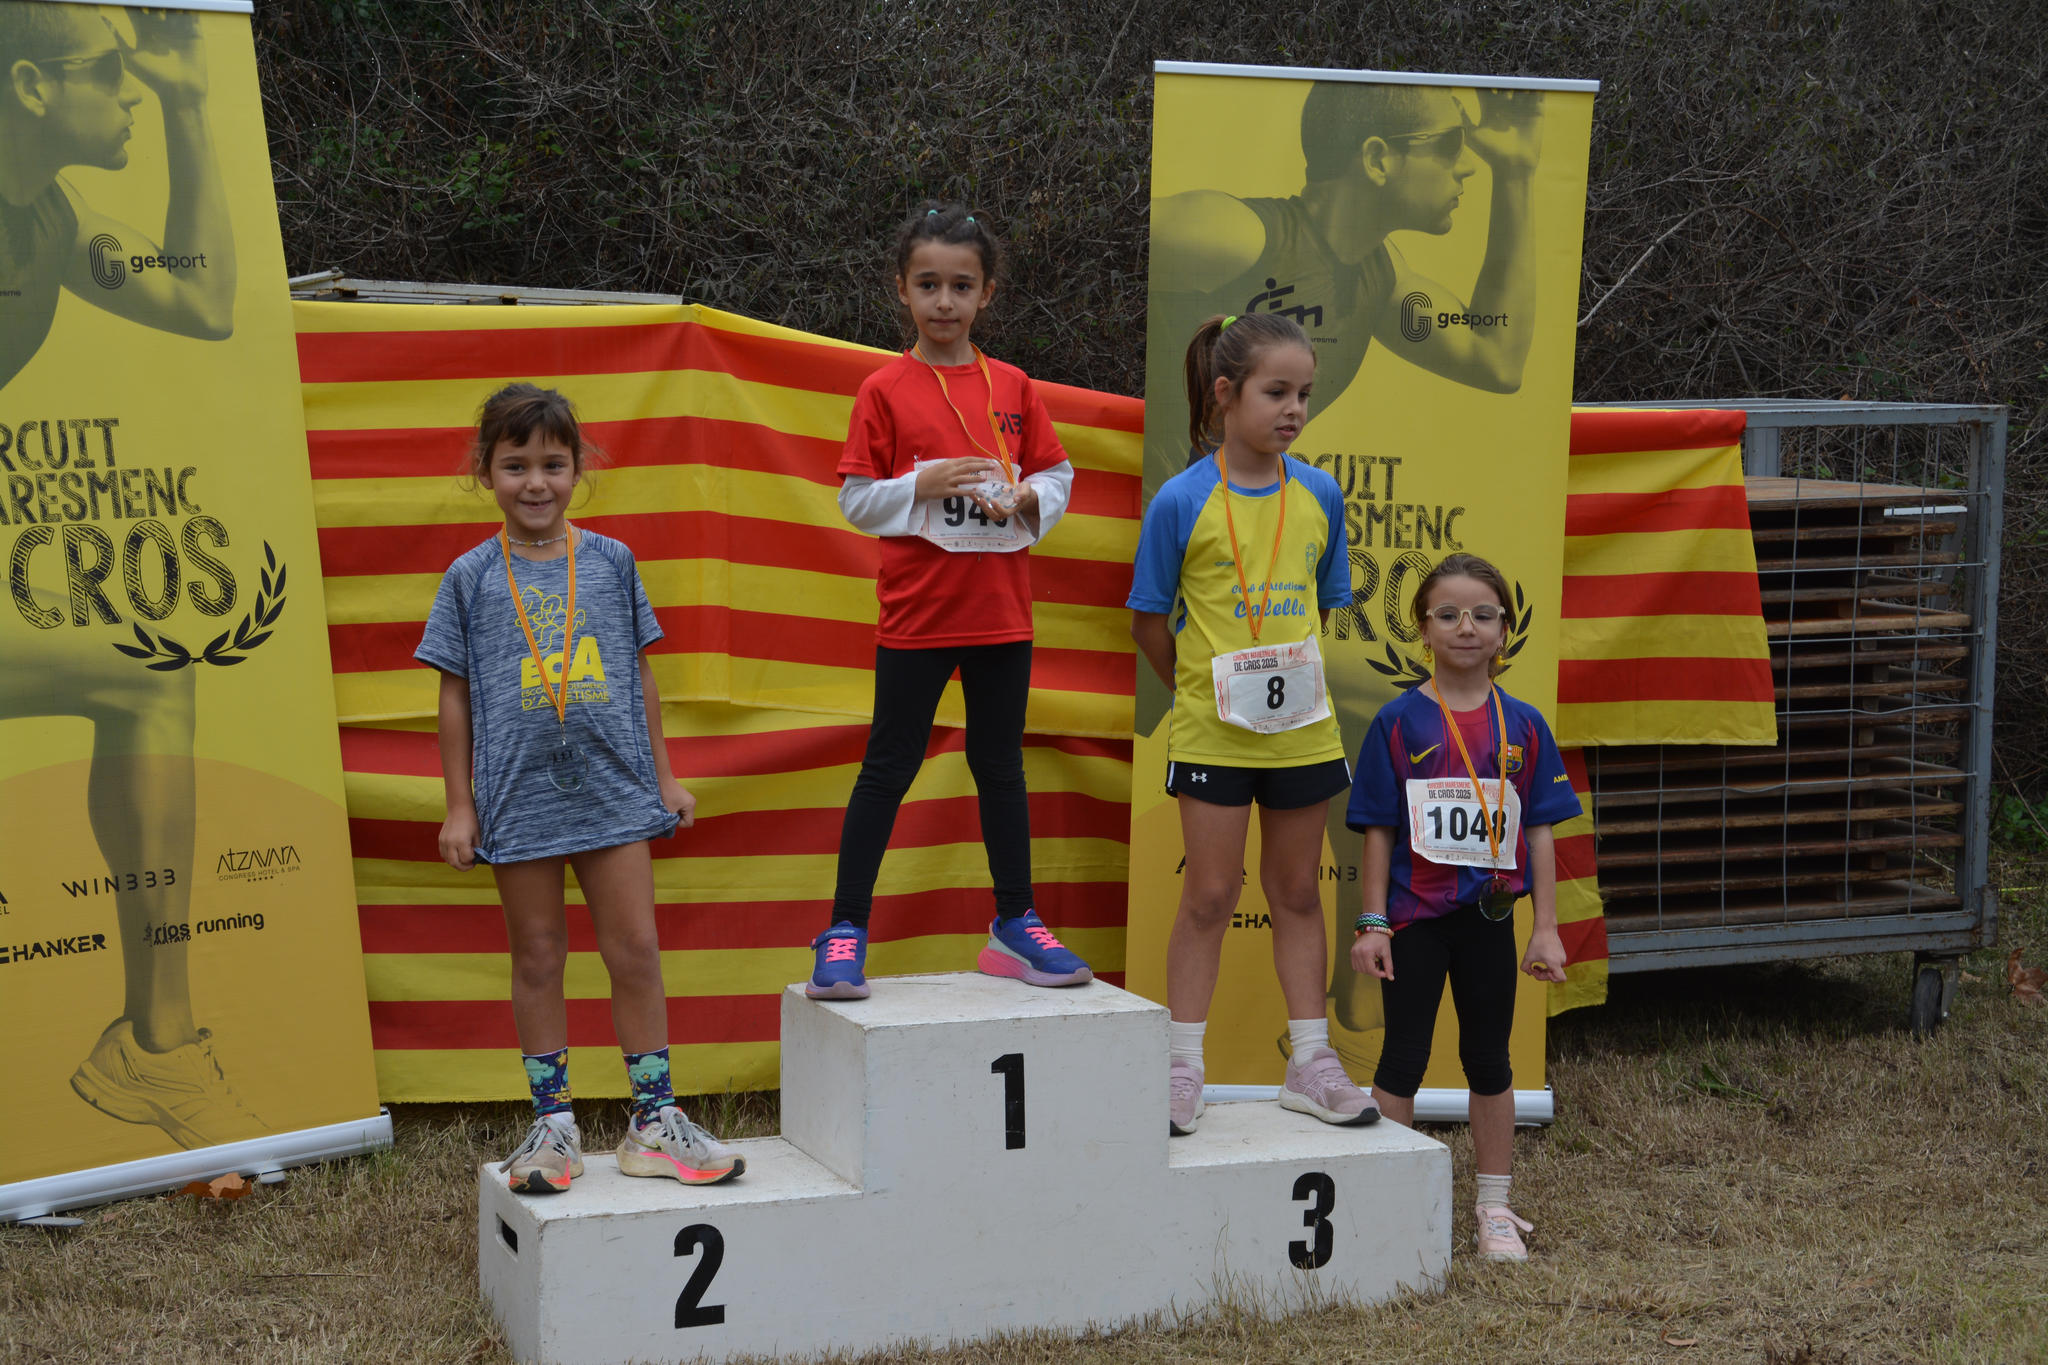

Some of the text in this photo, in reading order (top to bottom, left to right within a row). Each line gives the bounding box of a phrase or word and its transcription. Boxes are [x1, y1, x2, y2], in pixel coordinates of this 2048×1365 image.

[130, 252, 207, 274] gesport
[1437, 310, 1508, 330] gesport
[1289, 452, 1402, 500] UIT
[943, 496, 1008, 528] 94
[10, 516, 238, 629] CROS
[1321, 549, 1433, 643] RO
[521, 636, 606, 689] ECA
[1234, 657, 1278, 672] DE CROS 2025
[1267, 676, 1285, 710] 8
[1428, 789, 1471, 799] DE CROS 2025
[1427, 806, 1507, 844] 1048
[196, 913, 264, 931] running
[992, 1053, 1025, 1150] 1
[1289, 1172, 1335, 1270] 3
[674, 1224, 724, 1329] 2
